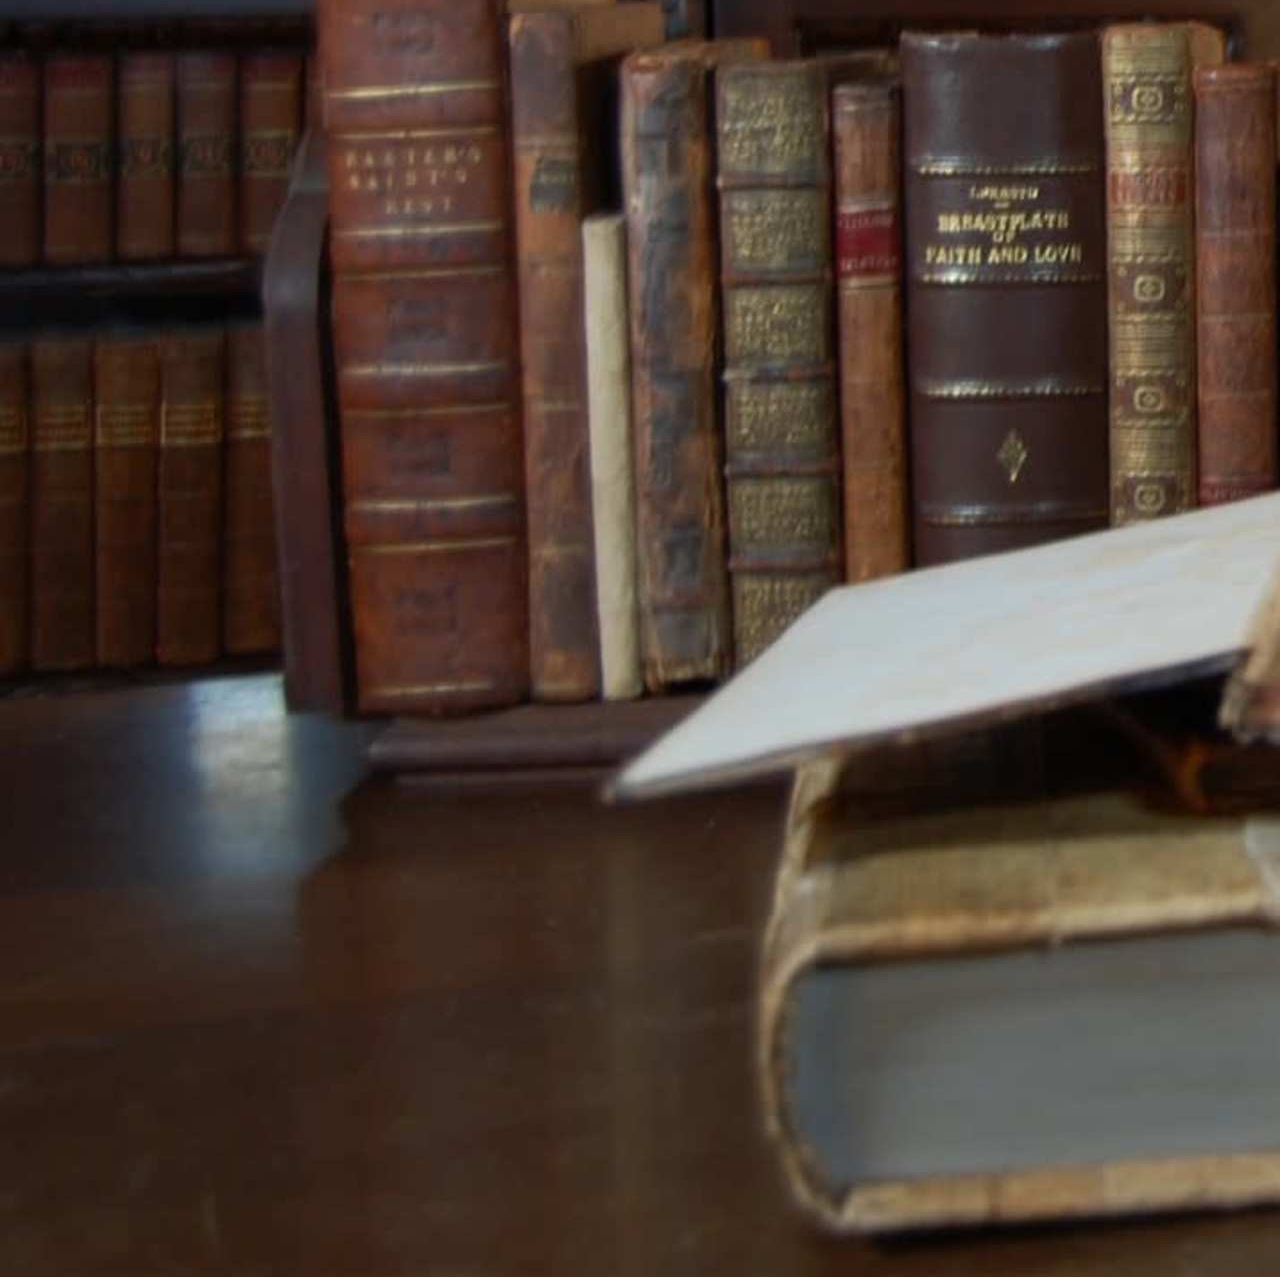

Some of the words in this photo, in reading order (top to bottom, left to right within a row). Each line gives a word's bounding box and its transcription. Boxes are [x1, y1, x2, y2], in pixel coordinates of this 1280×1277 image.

[937, 211, 1069, 233] BREASTPLATE
[992, 229, 1016, 244] OF
[925, 245, 982, 265] FAITH
[987, 245, 1029, 264] AND
[1034, 243, 1083, 263] LOVE
